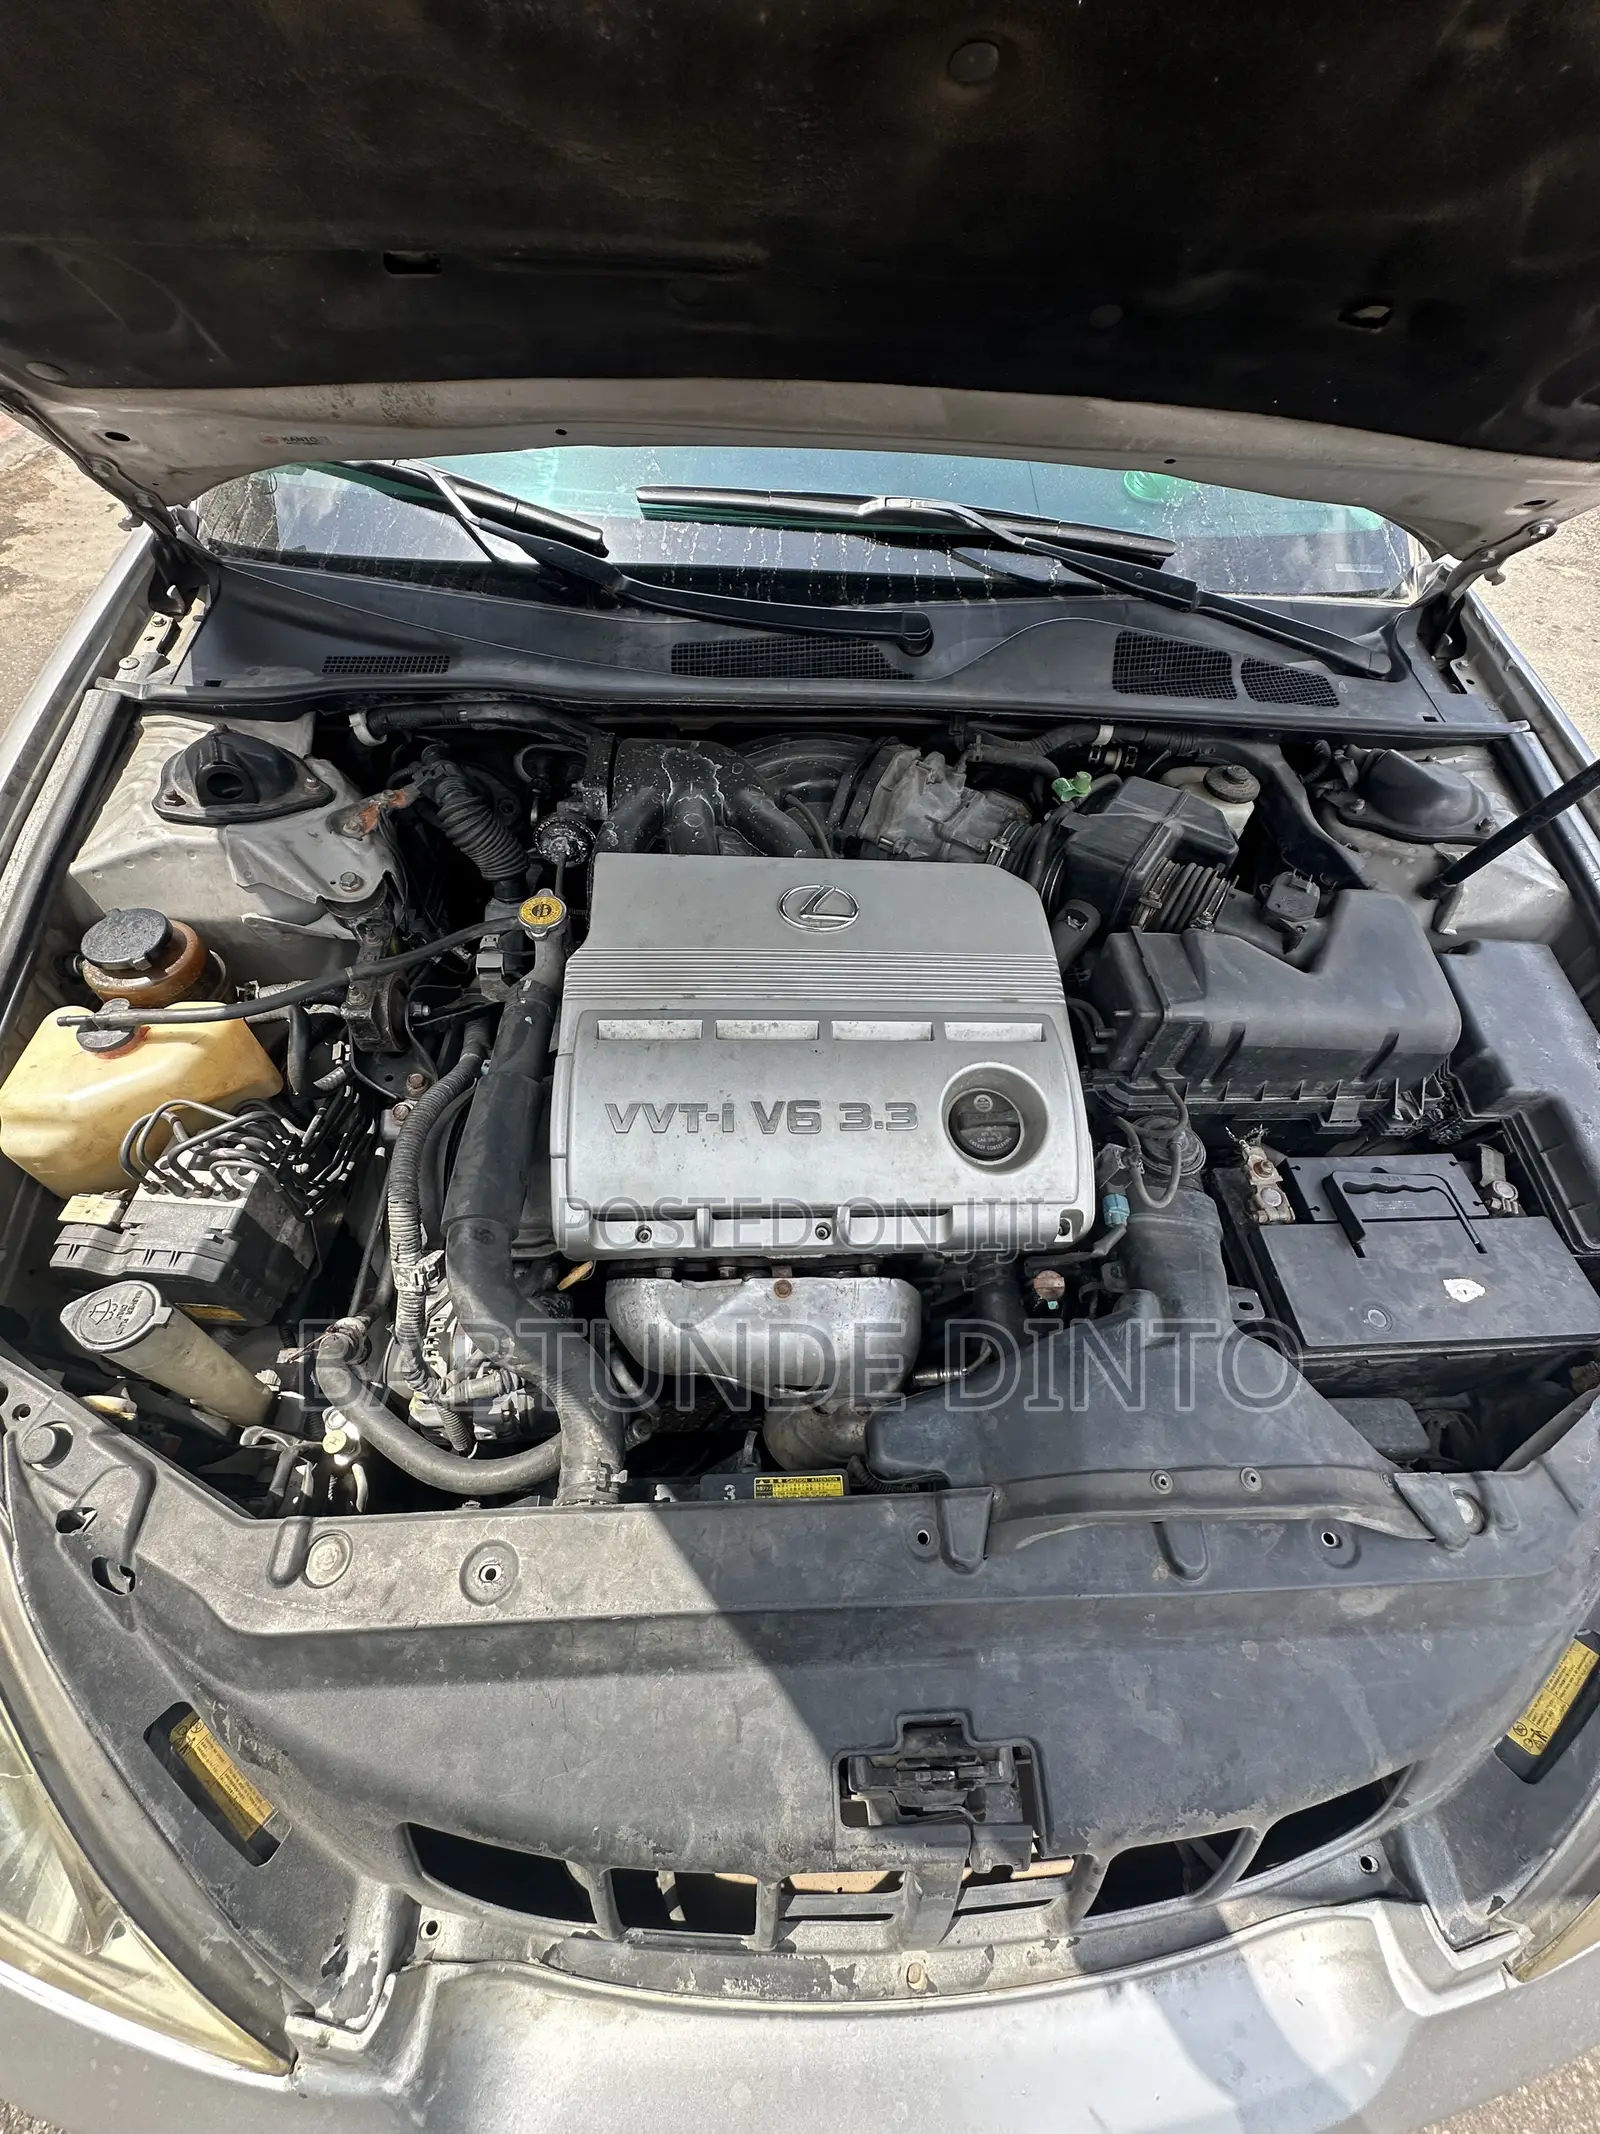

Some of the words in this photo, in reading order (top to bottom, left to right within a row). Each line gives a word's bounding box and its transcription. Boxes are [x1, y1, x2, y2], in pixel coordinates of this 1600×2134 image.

[604, 1102, 735, 1134] VVT-i
[750, 1099, 823, 1135] V6
[839, 1101, 919, 1131] 3.3
[723, 1484, 736, 1500] 3
